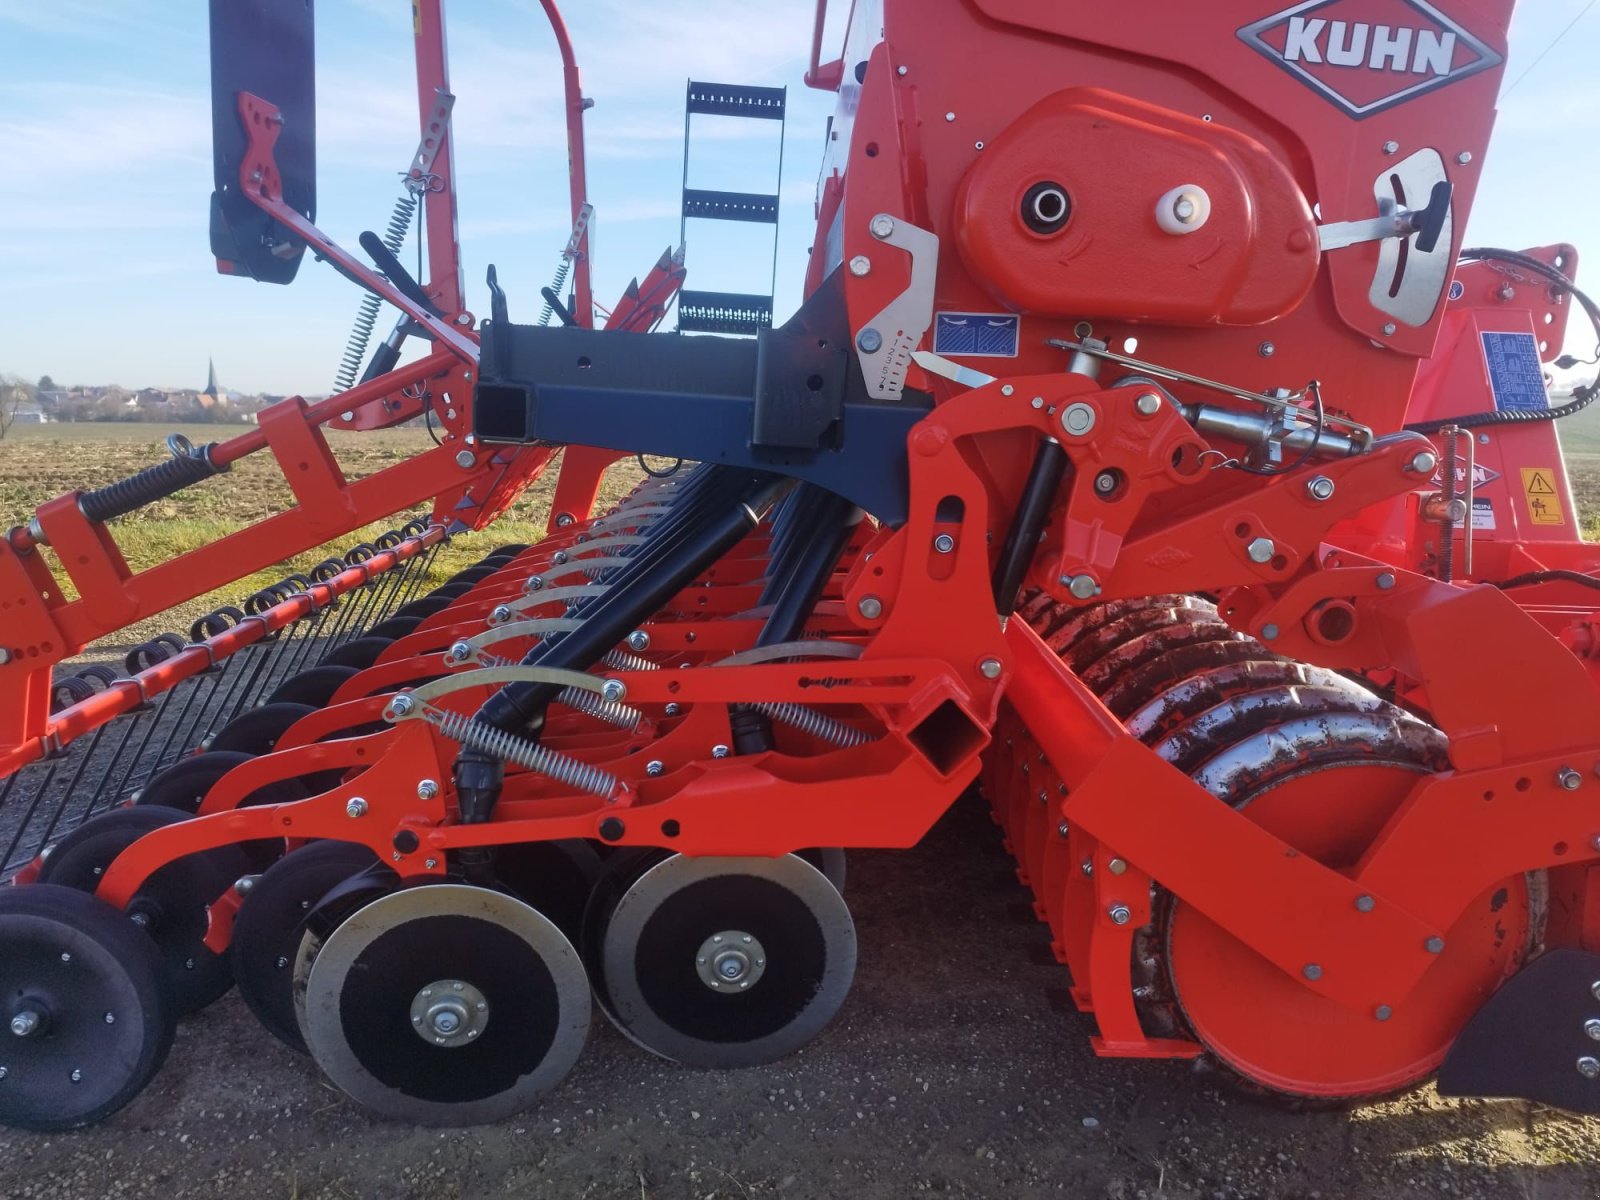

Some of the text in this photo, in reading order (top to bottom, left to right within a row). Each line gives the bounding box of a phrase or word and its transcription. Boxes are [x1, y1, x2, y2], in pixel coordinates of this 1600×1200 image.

[1283, 16, 1456, 76] KUHN
[888, 348, 895, 356] 2
[881, 376, 886, 384] 7
